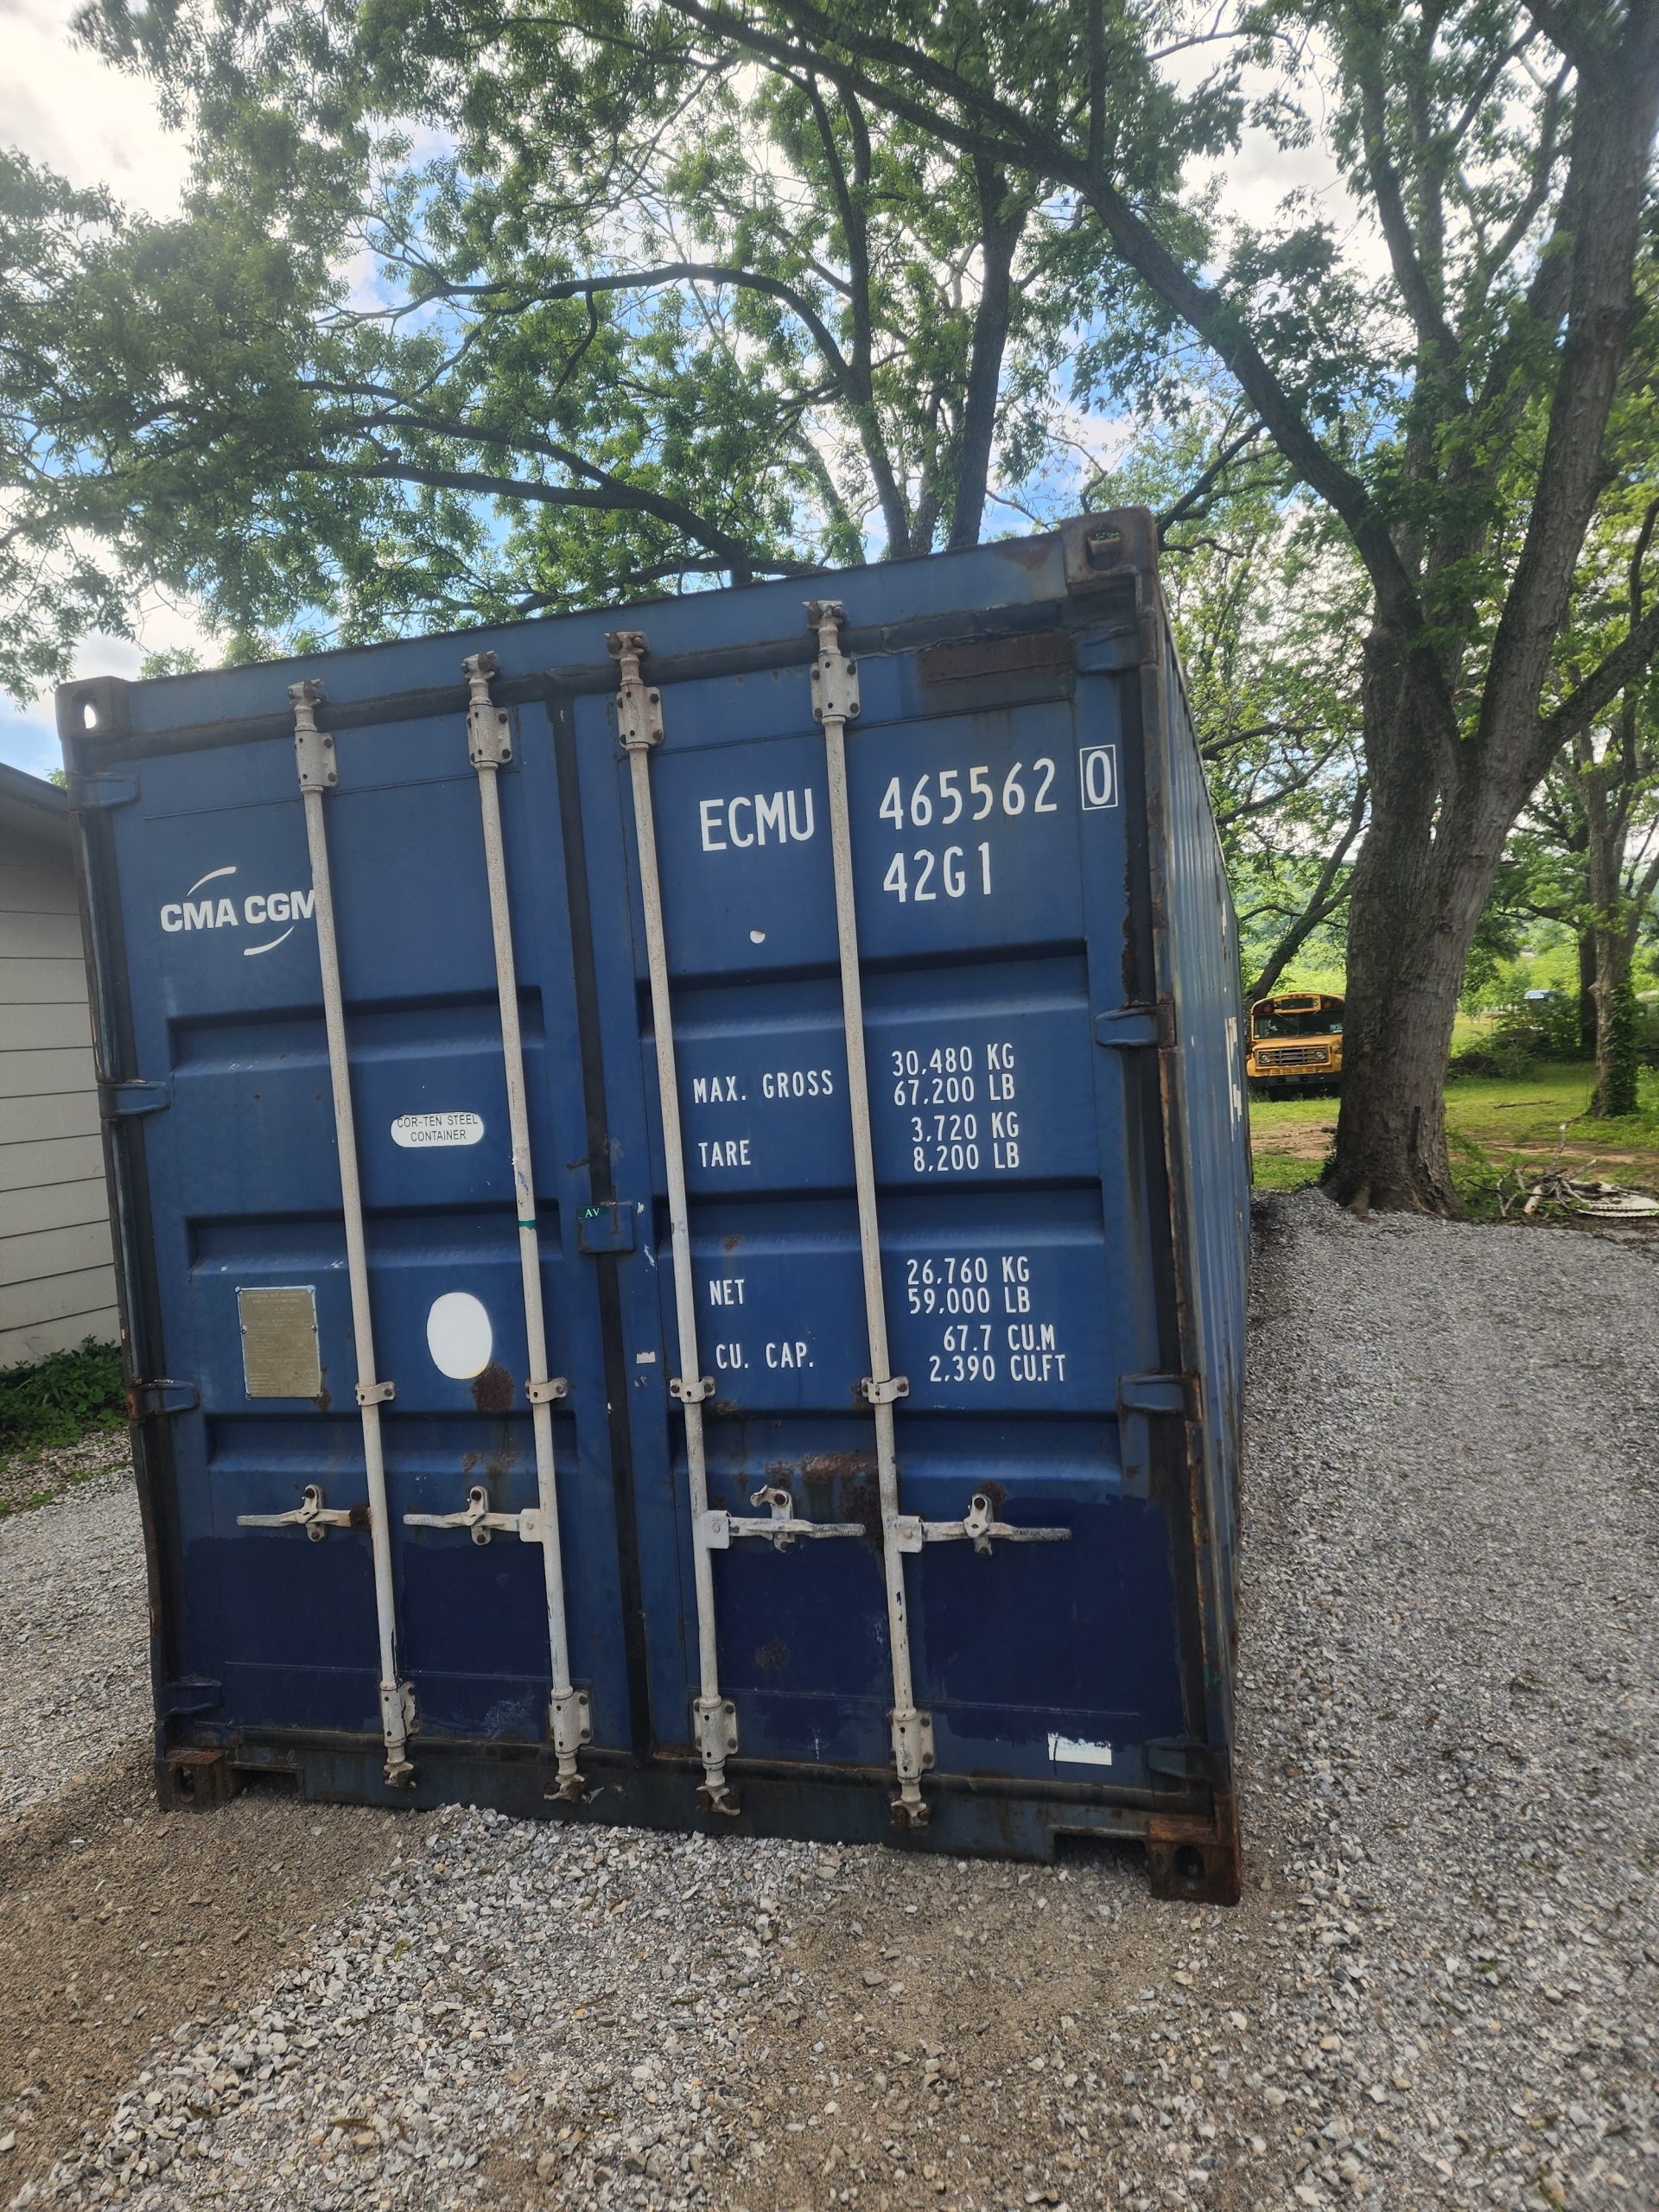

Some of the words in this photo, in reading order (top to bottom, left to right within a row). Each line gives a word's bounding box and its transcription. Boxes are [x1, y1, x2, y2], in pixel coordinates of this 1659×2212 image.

[699, 788, 815, 852] ECMU
[879, 758, 1058, 830] 465562
[1085, 750, 1113, 805] 0
[883, 842, 991, 903] 42G1
[160, 898, 239, 932] CMA
[244, 889, 316, 925] CGM
[891, 1046, 973, 1076] 30,480
[987, 1042, 1014, 1071] KG
[693, 1075, 747, 1103] MAX.
[762, 1069, 833, 1099] GROSS
[893, 1076, 975, 1106] 67,200
[988, 1073, 1015, 1101] LB
[397, 1116, 442, 1128] COR-TEN
[448, 1114, 478, 1125] STEEL
[410, 1129, 467, 1141] CONTAINER
[911, 1113, 977, 1142] 3,720
[991, 1111, 1019, 1139] KG
[697, 1139, 751, 1168] TARE
[913, 1143, 979, 1173] 8,200
[993, 1141, 1020, 1169] LB
[585, 1208, 600, 1217] AV
[906, 1256, 988, 1286] 26,760
[1001, 1255, 1030, 1283] KG
[709, 1279, 745, 1306] NET
[907, 1287, 990, 1314] 59,000
[1004, 1286, 1031, 1313] LB
[944, 1324, 992, 1351] 67.7
[1007, 1324, 1055, 1351] CU.M
[715, 1343, 749, 1370] CU.
[766, 1342, 814, 1369] CAP.
[929, 1355, 995, 1382] 2,390
[1010, 1354, 1065, 1382] CU.FT
